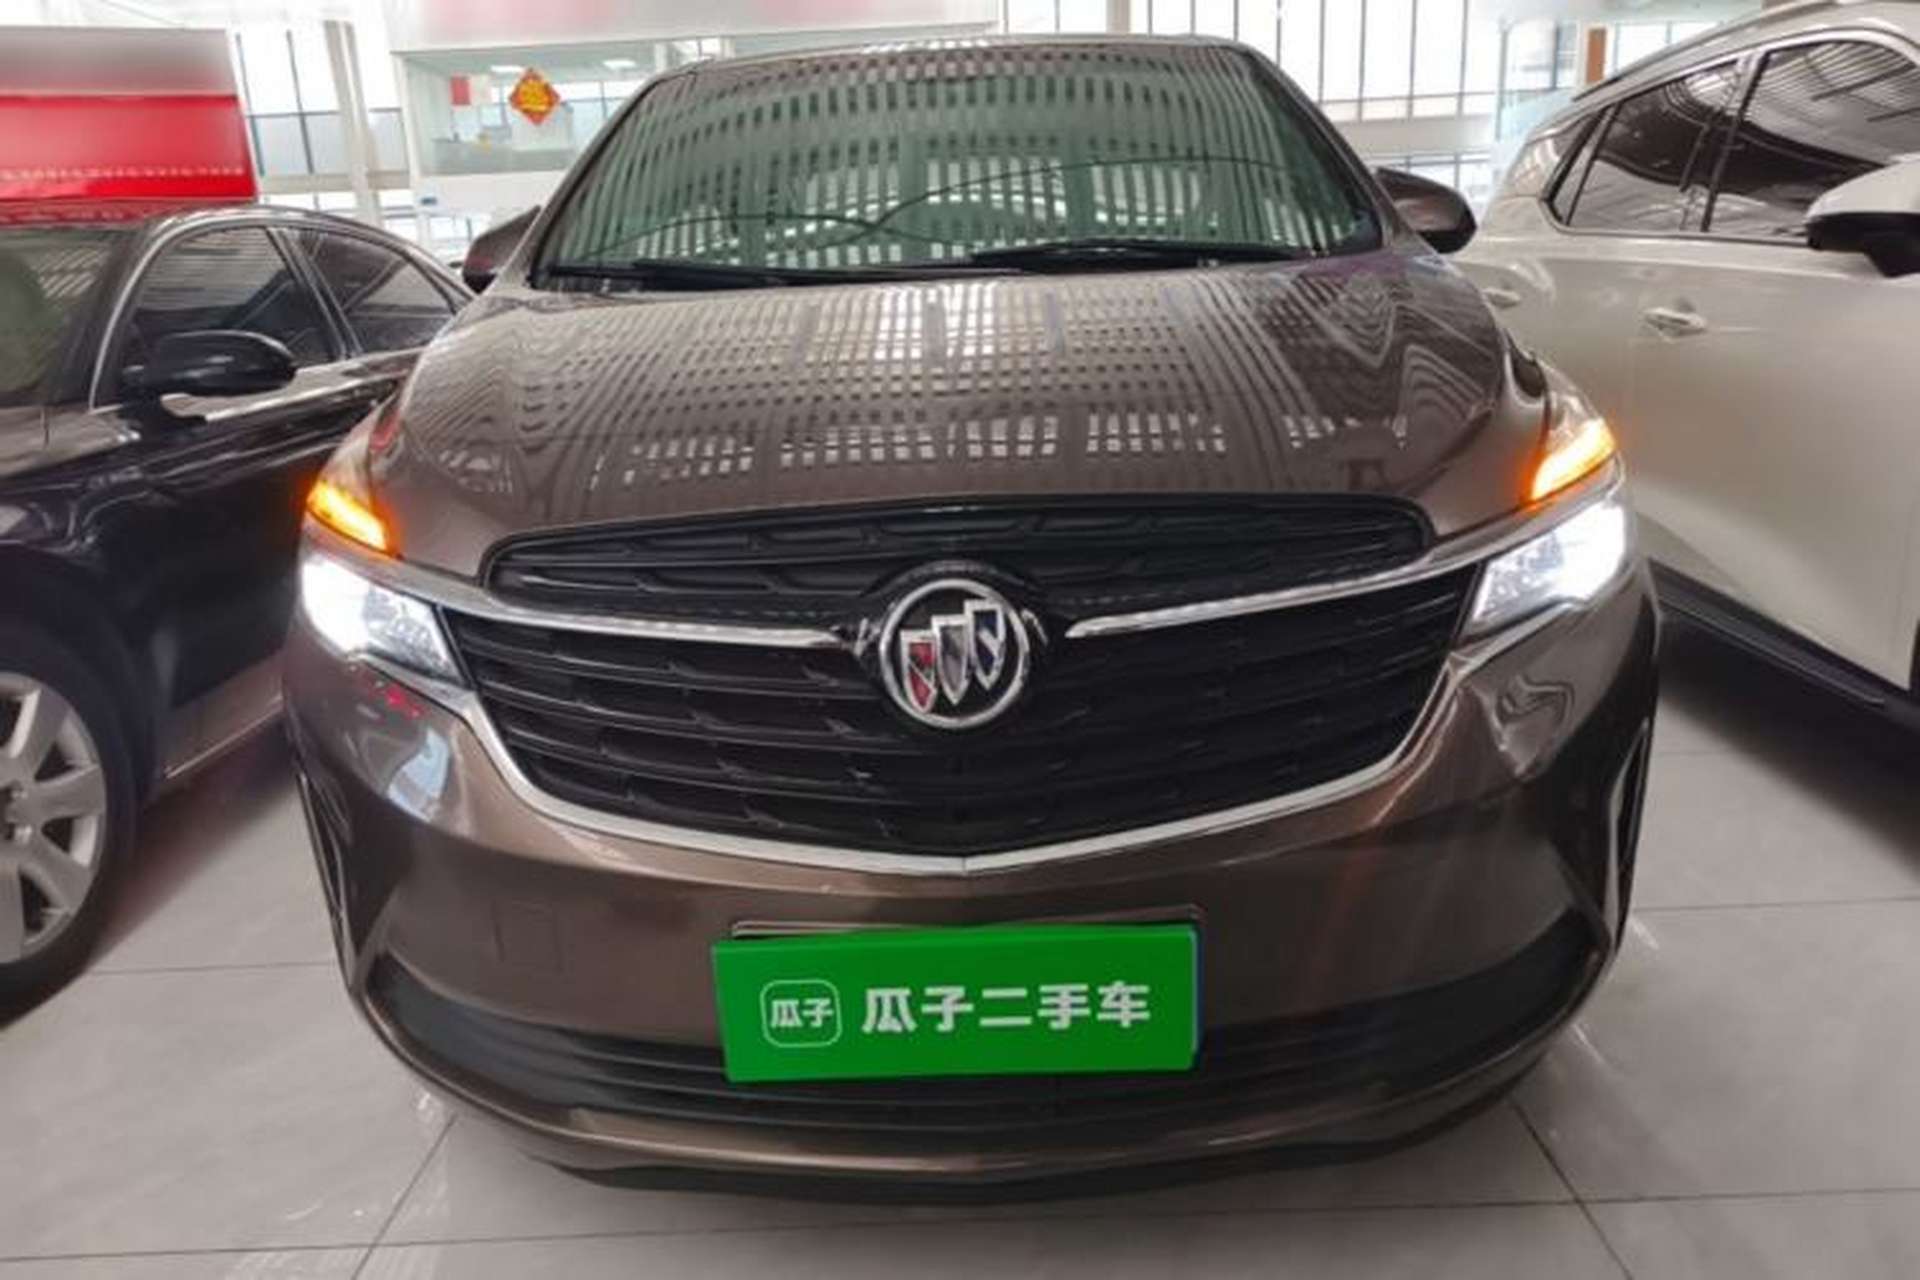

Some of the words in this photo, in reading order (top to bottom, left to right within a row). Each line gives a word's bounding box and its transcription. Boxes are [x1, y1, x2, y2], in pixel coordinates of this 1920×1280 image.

[770, 997, 834, 1029] 瓜子
[862, 980, 1151, 1034] 瓜子二手车
